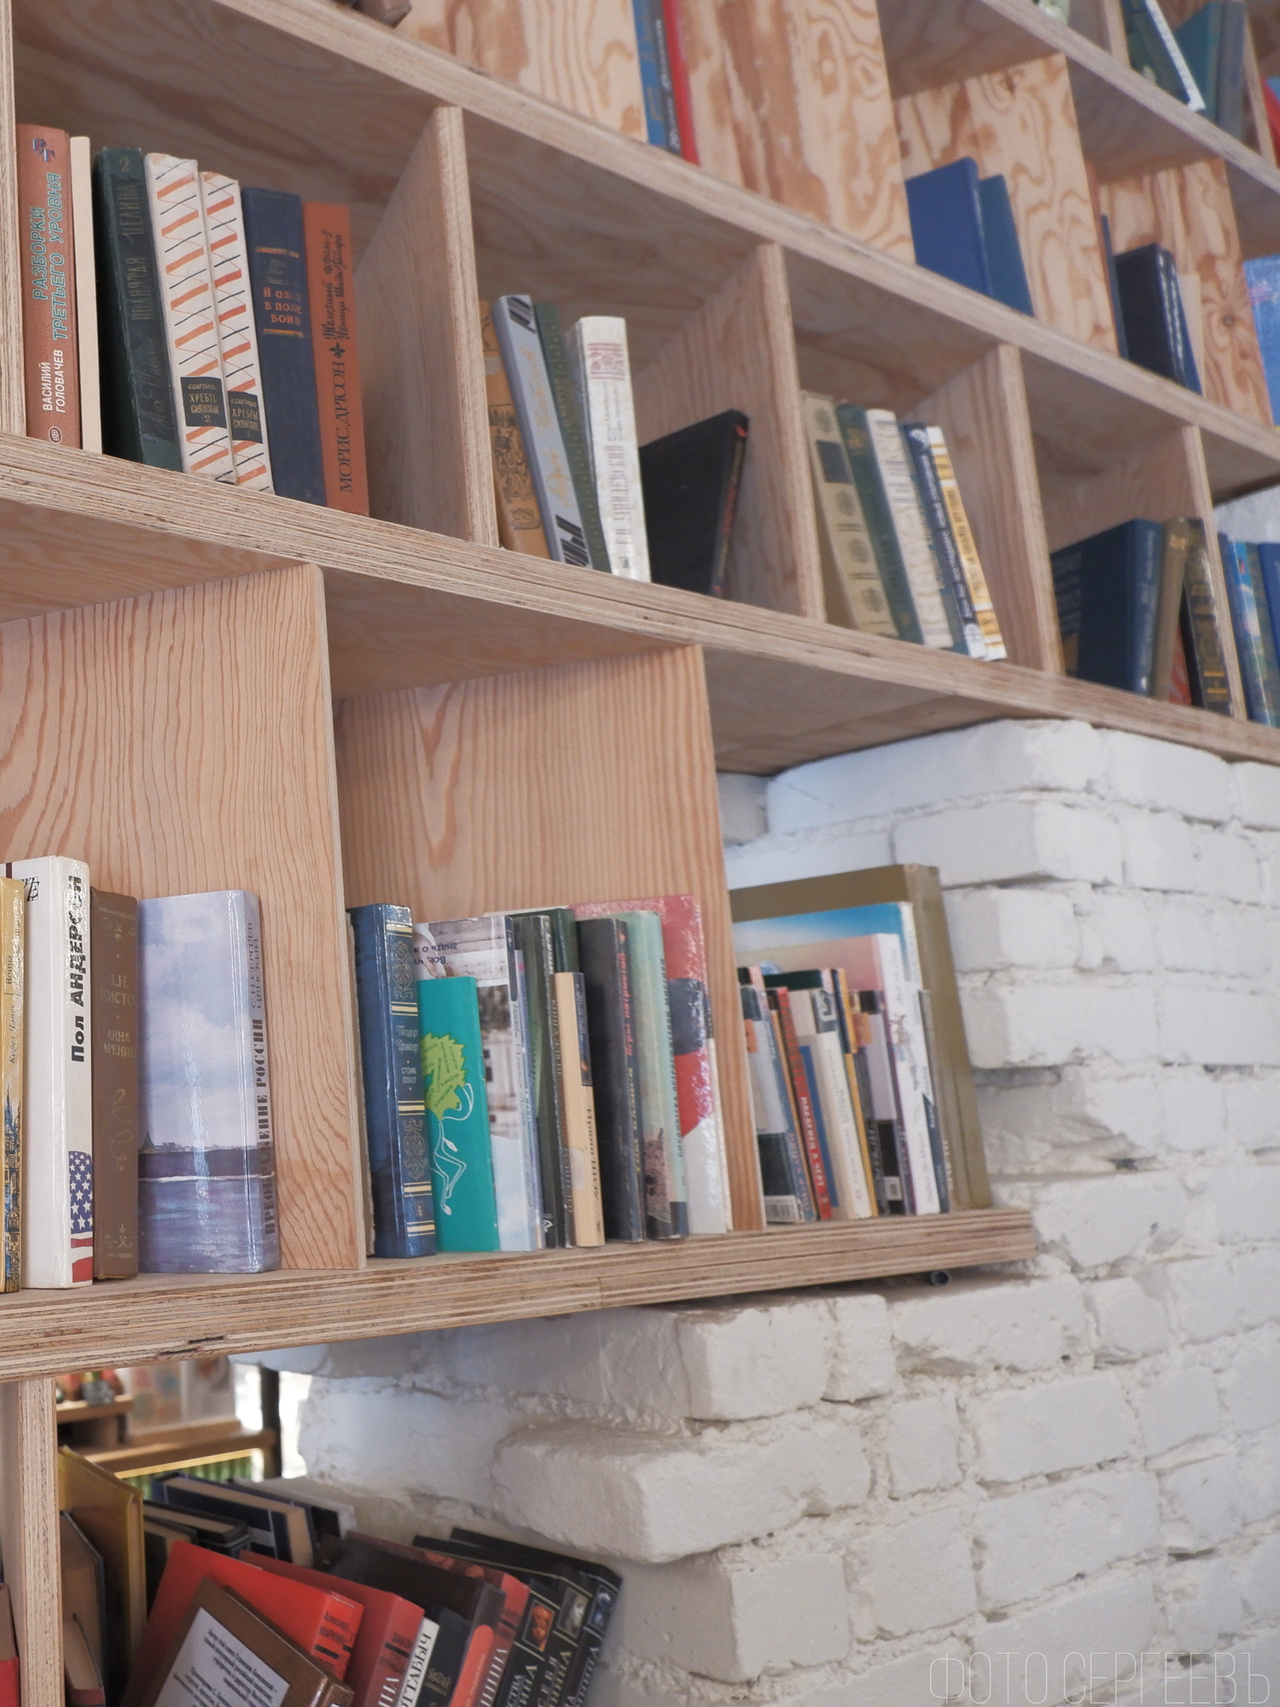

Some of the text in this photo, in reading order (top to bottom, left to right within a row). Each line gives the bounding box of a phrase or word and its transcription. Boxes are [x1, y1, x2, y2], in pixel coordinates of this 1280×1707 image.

[29, 206, 48, 301] РАЗБОРКИ
[46, 172, 68, 341] ТРЕТЬЕГО УРОВНЯ
[263, 287, 272, 298] И
[264, 301, 272, 311] В
[38, 361, 53, 411] ВАСИЛИЙ
[52, 349, 67, 413] ГОЛОВАЧЕВ
[332, 360, 354, 493] МОРИС ДРЮОН
[71, 1015, 85, 1063] Пол
[251, 1018, 267, 1088] РОССИИ
